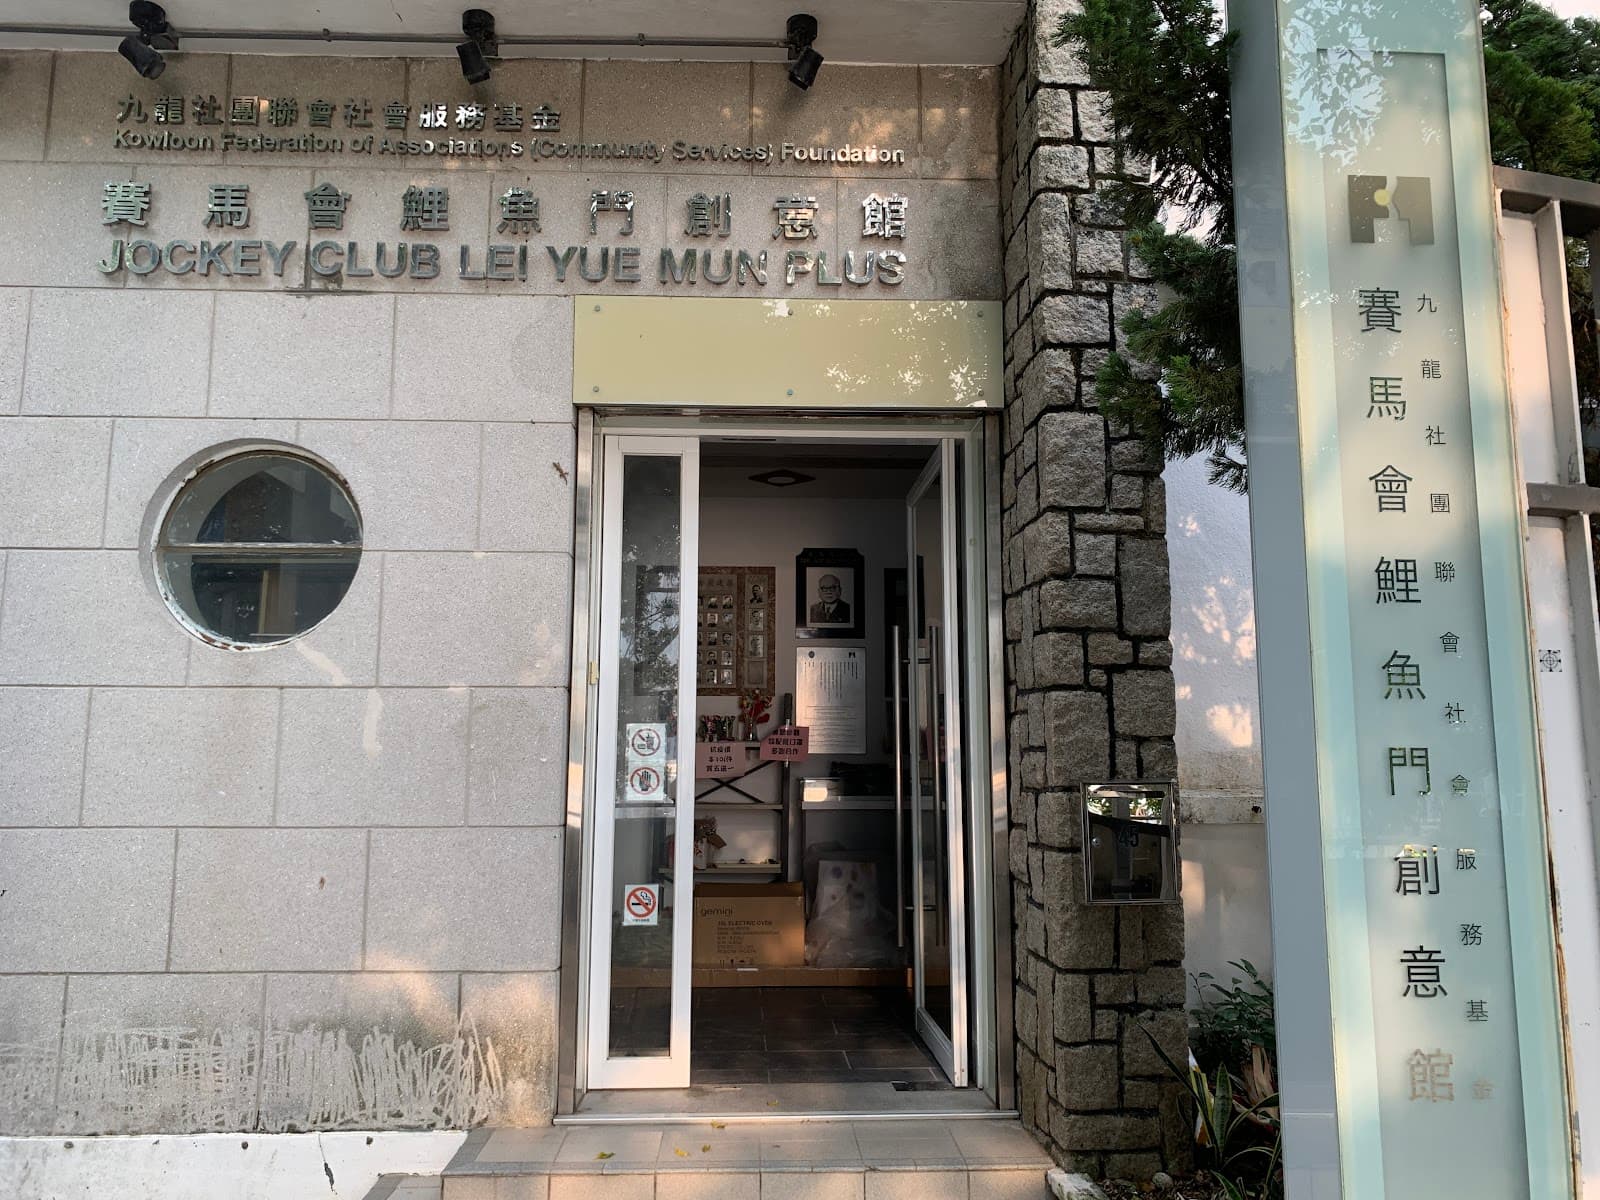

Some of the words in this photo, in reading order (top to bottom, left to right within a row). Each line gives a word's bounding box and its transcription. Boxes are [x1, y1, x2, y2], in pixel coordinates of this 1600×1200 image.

[115, 94, 561, 132] 九龍社團聯會社會服務基金
[113, 129, 213, 152] Kowloon
[222, 133, 343, 153] Federation
[351, 134, 374, 153] of
[378, 135, 524, 156] Associations
[529, 137, 666, 163] (Community
[672, 140, 773, 163] Services)
[781, 142, 905, 165] Foundation
[101, 181, 909, 239] 賽馬會鯉魚門創意館
[99, 239, 297, 277] JOCKEY
[310, 240, 441, 280] CLUB
[459, 243, 528, 281] LEI
[546, 245, 642, 283] YUE
[660, 247, 768, 286] MUN
[785, 249, 907, 288] PLUS
[1358, 287, 1456, 1104] 賽馬會鯉魚門創意館
[1416, 294, 1494, 1100] 九龍社團聯會社會服務基金
